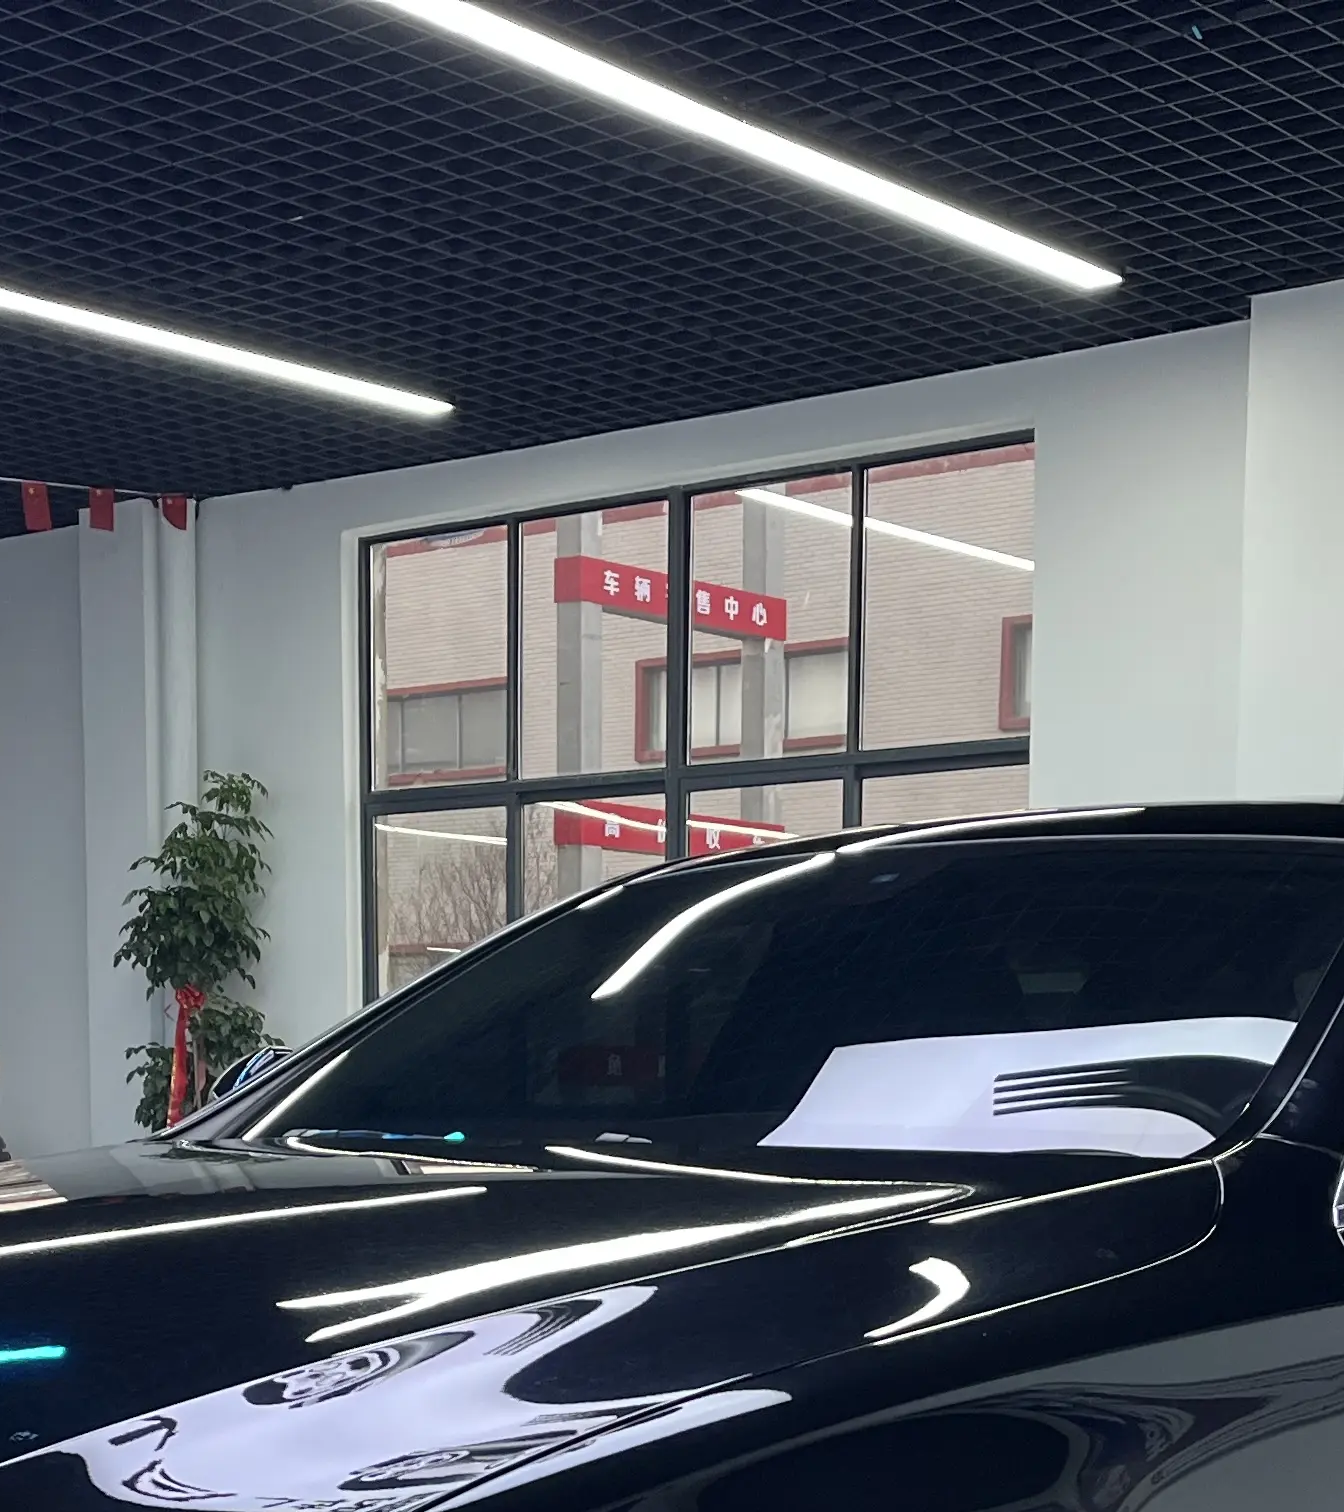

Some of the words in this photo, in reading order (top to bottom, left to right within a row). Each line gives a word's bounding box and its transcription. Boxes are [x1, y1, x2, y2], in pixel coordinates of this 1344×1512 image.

[603, 569, 768, 627] 车辆售中心
